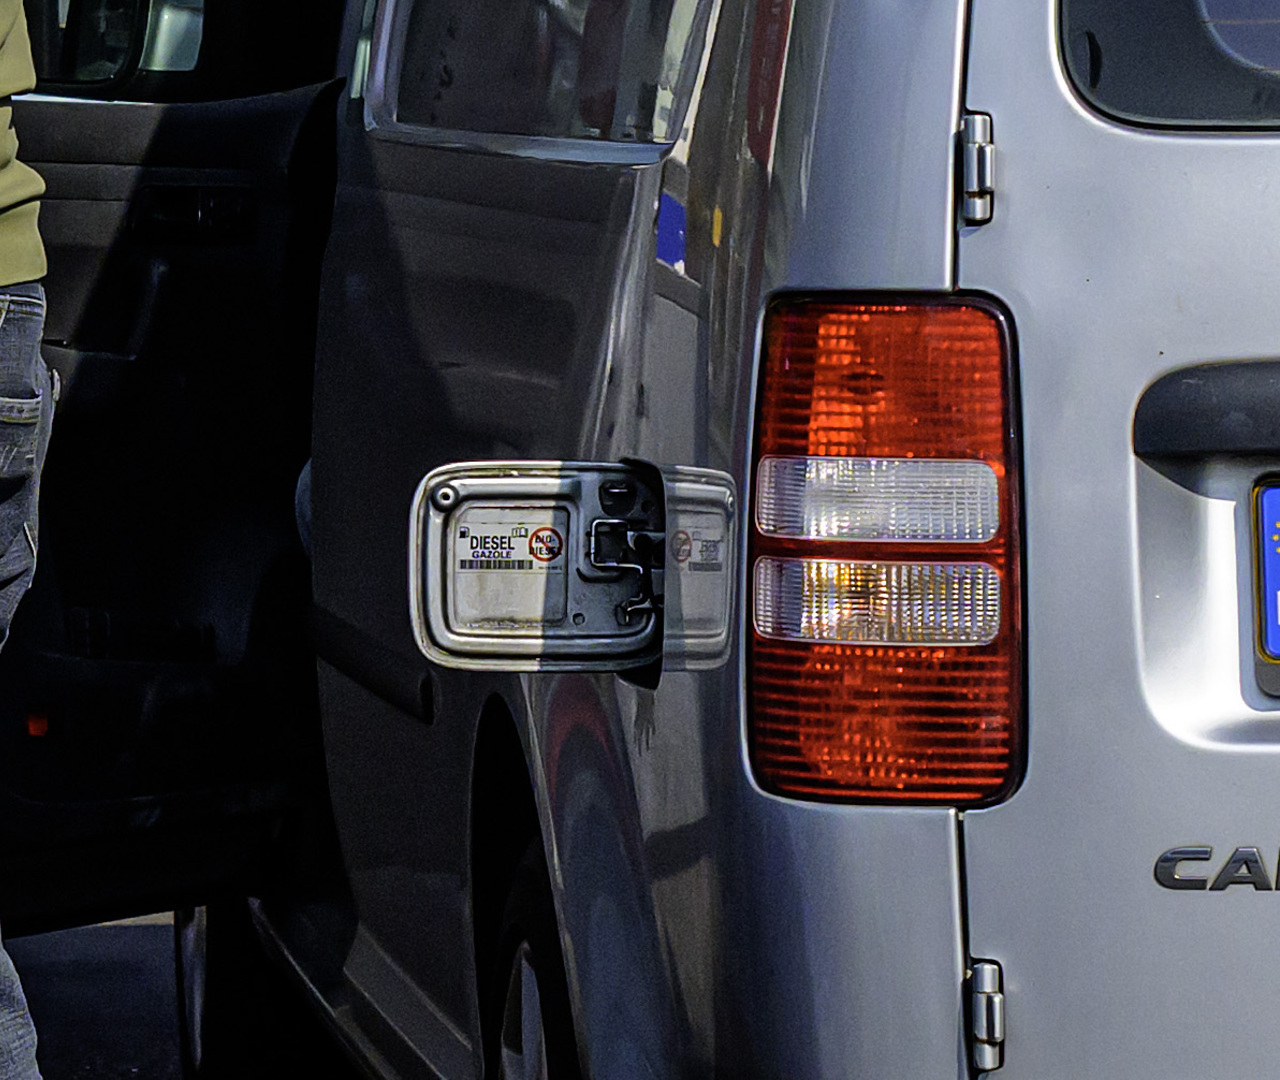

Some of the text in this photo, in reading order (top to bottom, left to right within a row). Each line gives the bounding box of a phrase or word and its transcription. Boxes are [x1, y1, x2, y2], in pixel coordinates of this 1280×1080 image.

[470, 535, 515, 550] DIESEL
[471, 550, 512, 559] GAZOLE
[1153, 846, 1280, 892] CA
